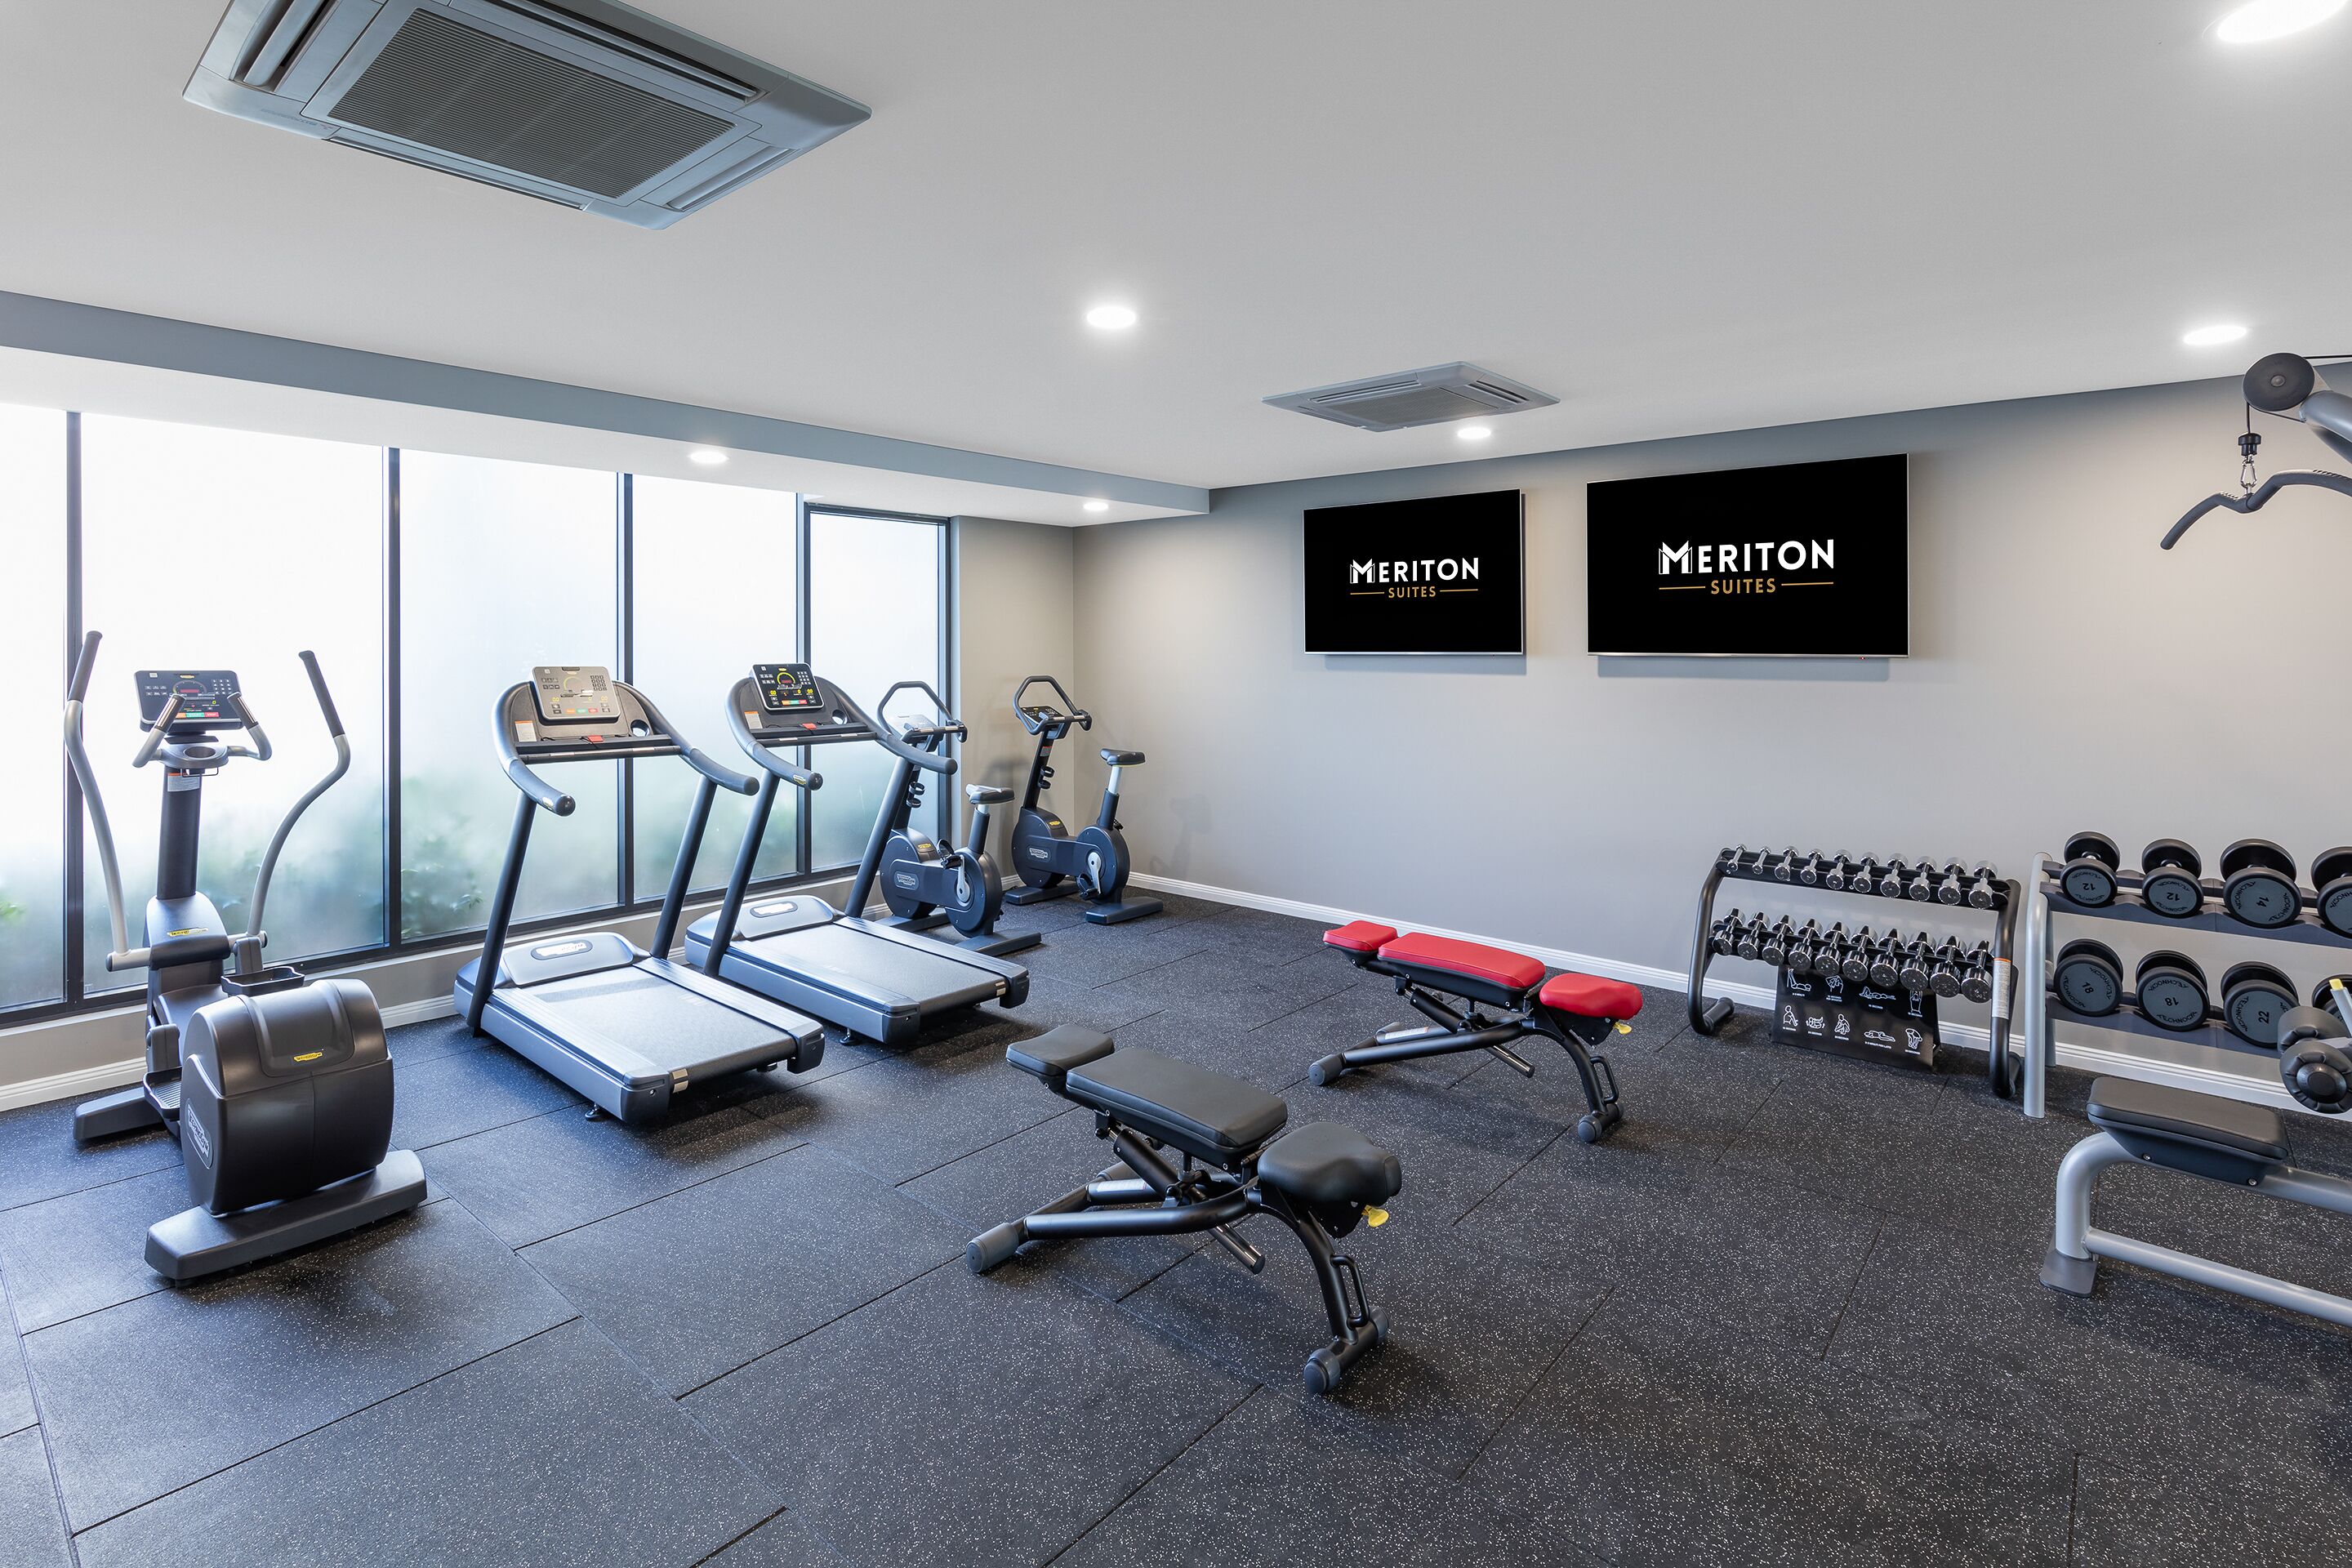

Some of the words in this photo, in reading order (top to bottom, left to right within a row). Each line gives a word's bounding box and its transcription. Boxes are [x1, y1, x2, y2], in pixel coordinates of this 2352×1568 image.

[1658, 538, 1834, 575] MERITON
[1349, 557, 1479, 585] MERITON
[1710, 577, 1776, 595] SUITES
[1388, 586, 1437, 599] SUITES
[2082, 882, 2096, 891] 12
[2166, 892, 2180, 902] 12
[2256, 896, 2270, 907] 14
[2082, 982, 2095, 994] 18
[2164, 996, 2180, 1007] 18
[2258, 1010, 2270, 1024] 22
